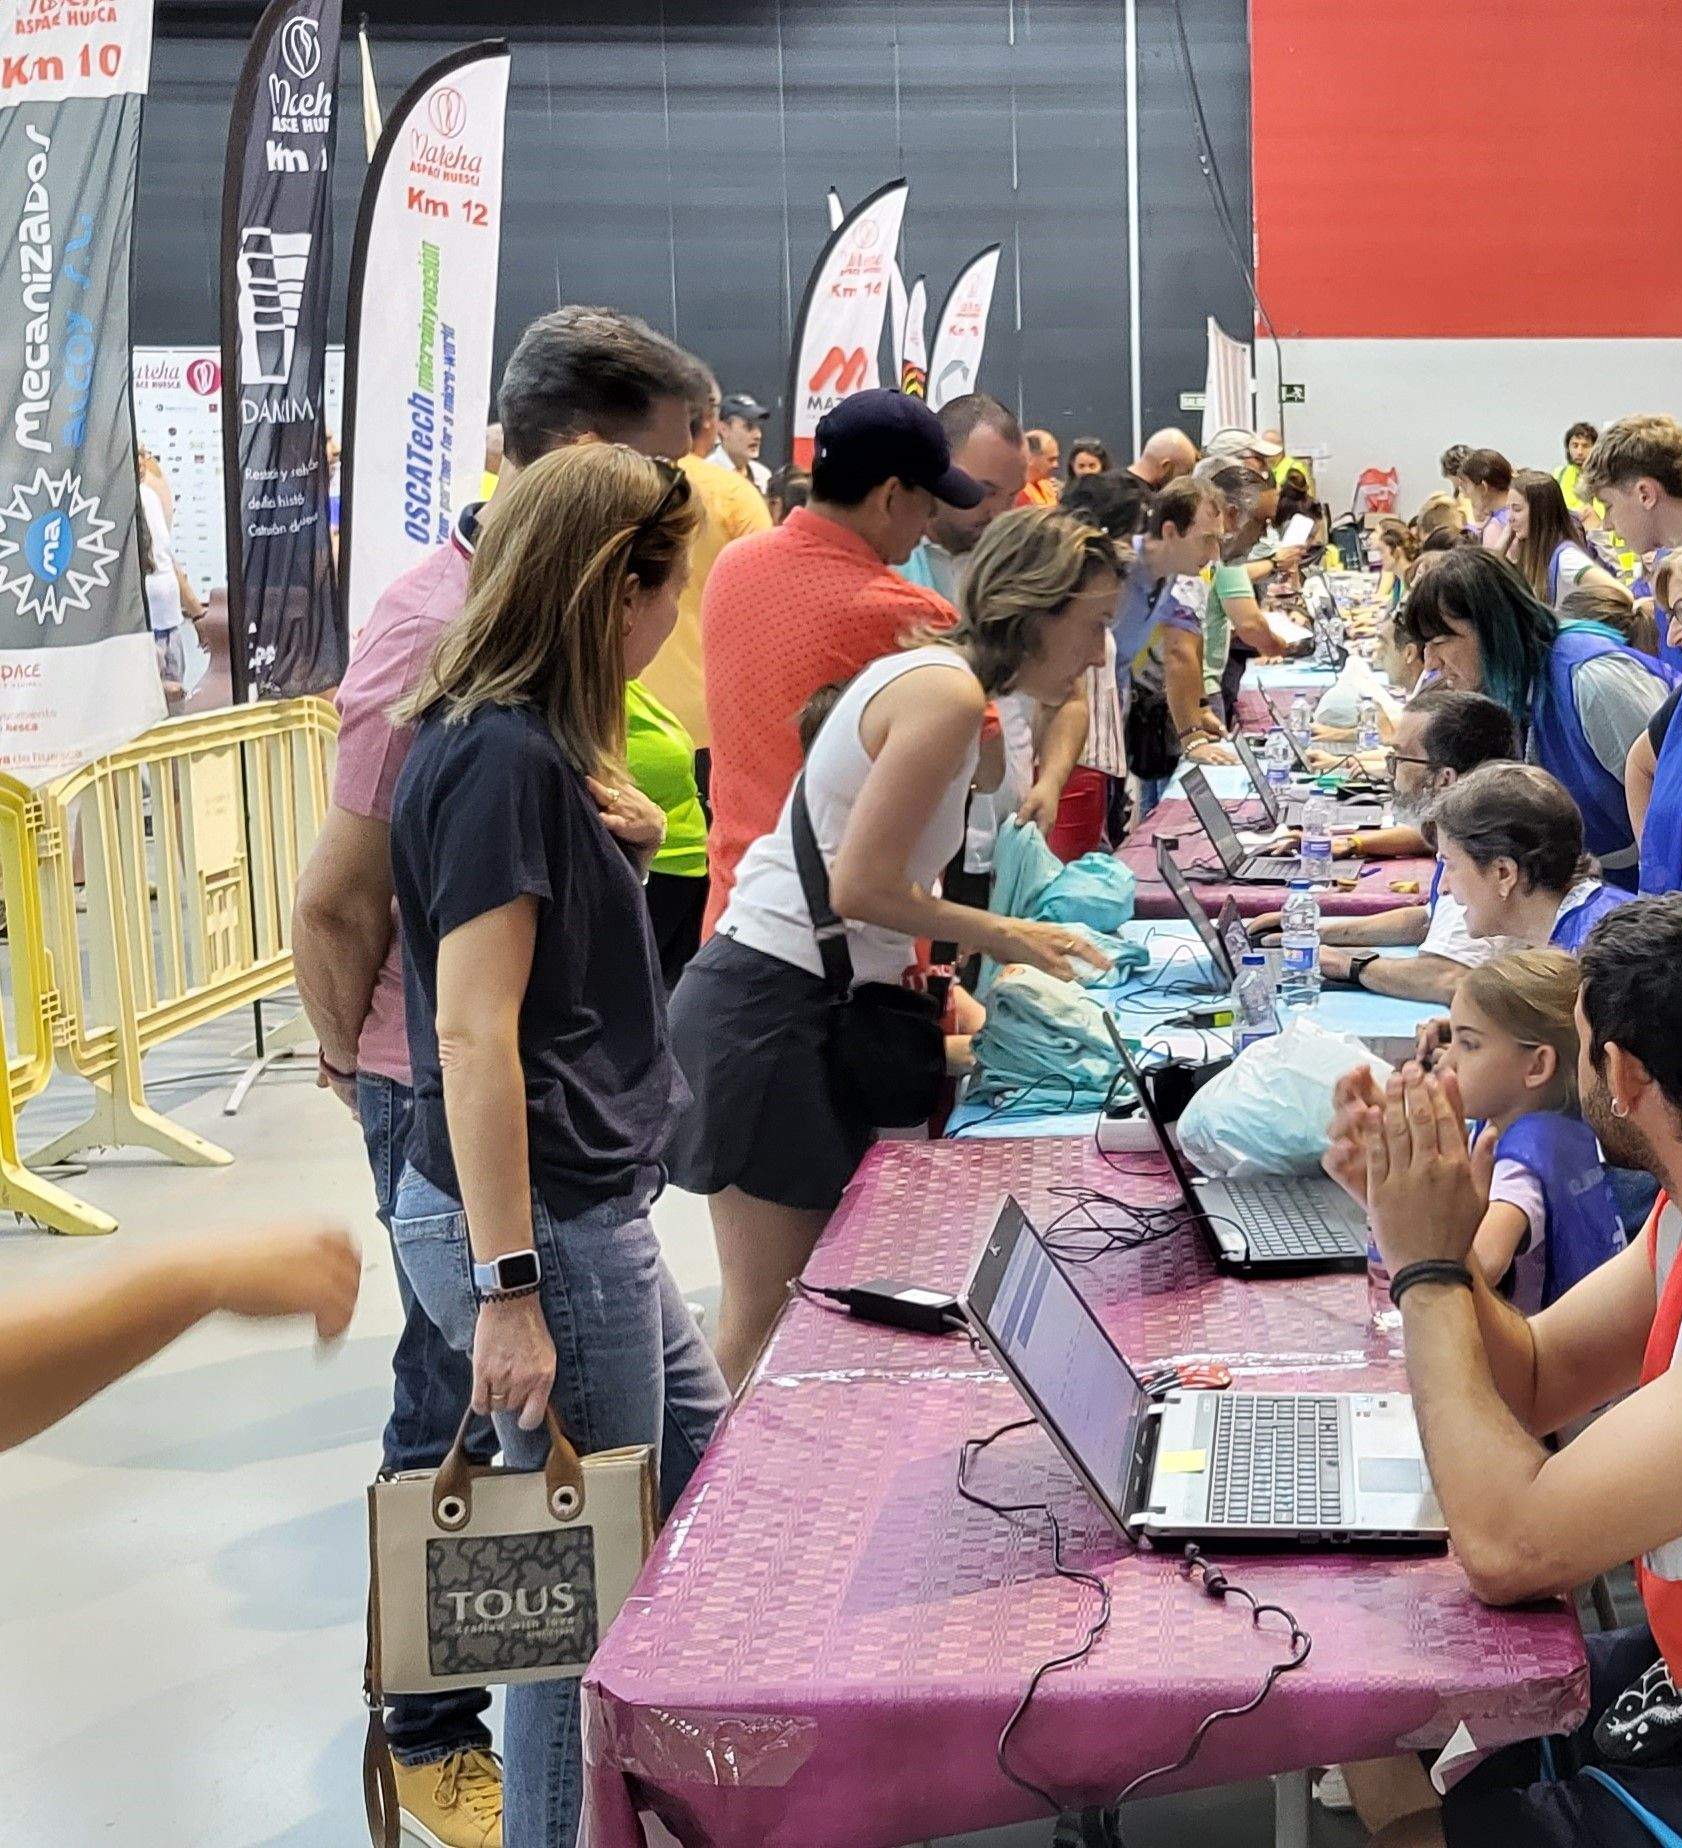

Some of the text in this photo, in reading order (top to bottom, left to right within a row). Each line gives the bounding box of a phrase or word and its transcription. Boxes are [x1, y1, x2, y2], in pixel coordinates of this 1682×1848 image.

[2, 43, 122, 88] Km 10
[407, 186, 488, 227] Km 12
[404, 391, 435, 545] OSCATech
[446, 1581, 577, 1622] TOUS
